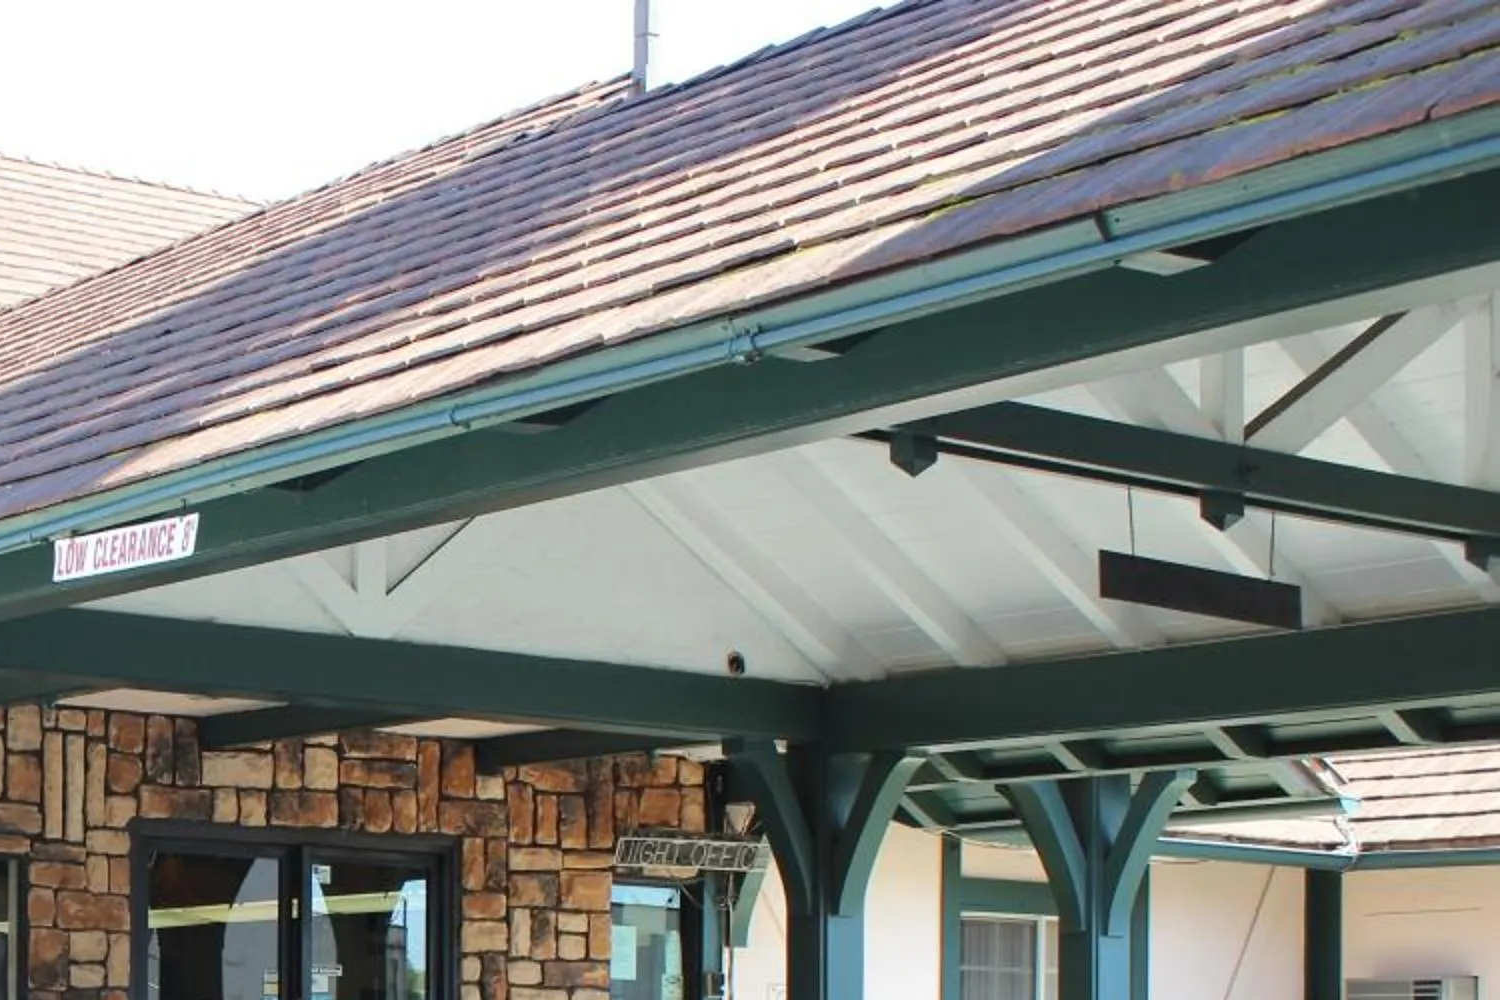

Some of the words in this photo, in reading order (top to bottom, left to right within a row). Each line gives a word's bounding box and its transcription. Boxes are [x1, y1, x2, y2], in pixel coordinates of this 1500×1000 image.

[57, 541, 88, 575] LOW
[94, 524, 176, 568] CLEARANCE
[617, 841, 678, 866] NIGHT
